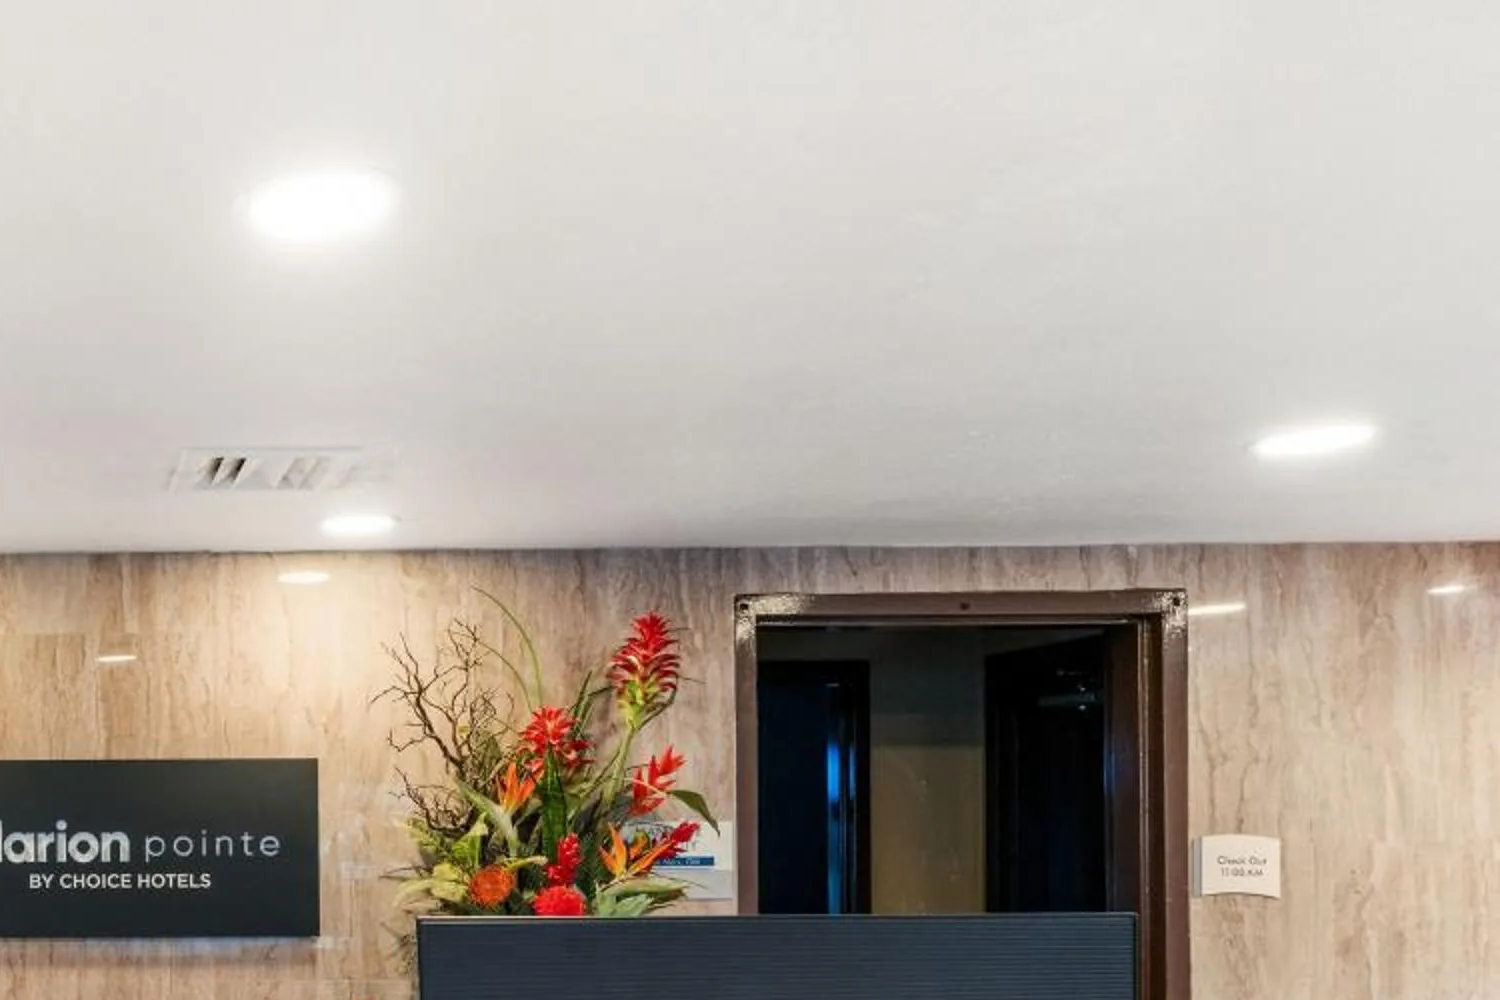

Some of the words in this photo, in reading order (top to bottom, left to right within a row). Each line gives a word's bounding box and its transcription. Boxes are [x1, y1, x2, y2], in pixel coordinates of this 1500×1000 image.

[144, 829, 282, 863] pointe
[29, 873, 51, 889] BY
[59, 873, 132, 889] CHOICE
[137, 873, 212, 889] HOTELS
